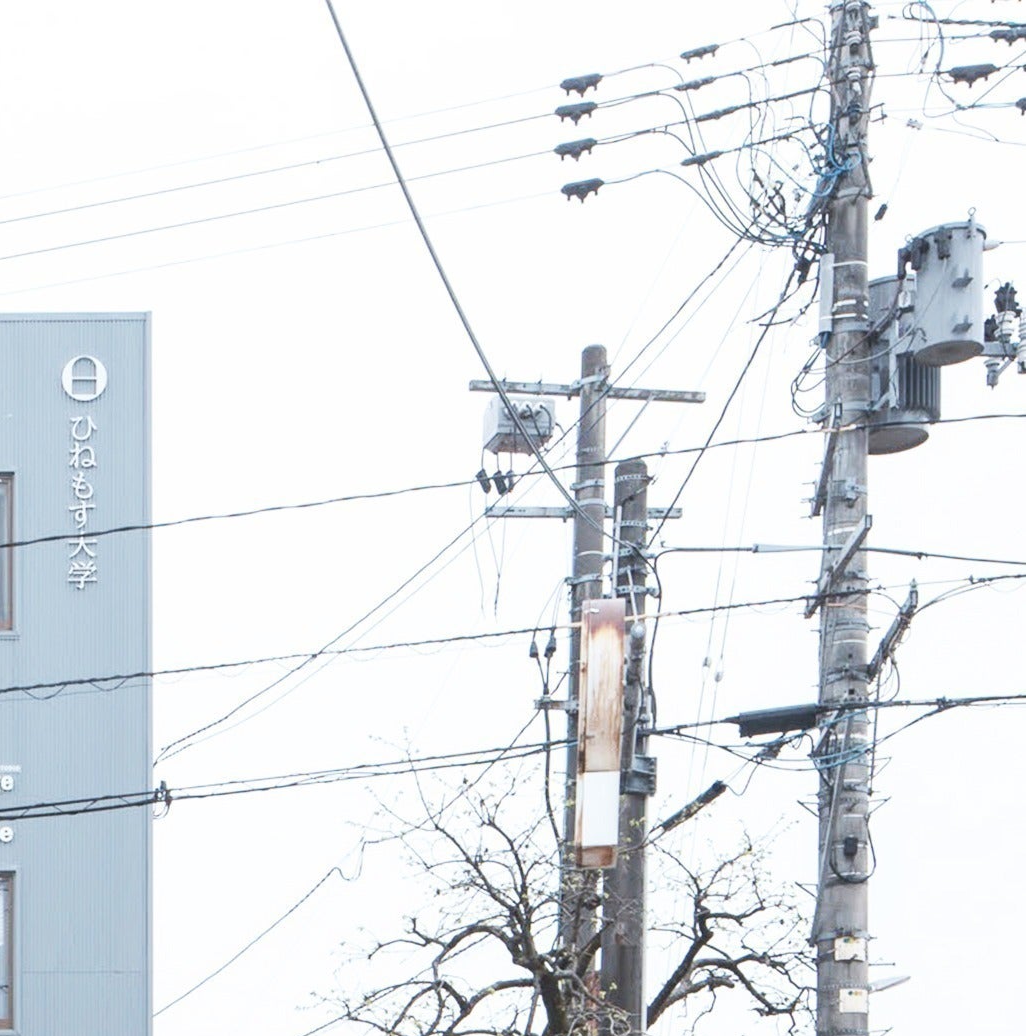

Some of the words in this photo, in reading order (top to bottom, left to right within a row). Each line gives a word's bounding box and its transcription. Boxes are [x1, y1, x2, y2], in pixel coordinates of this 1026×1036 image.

[68, 415, 97, 588] ひねもす大学
